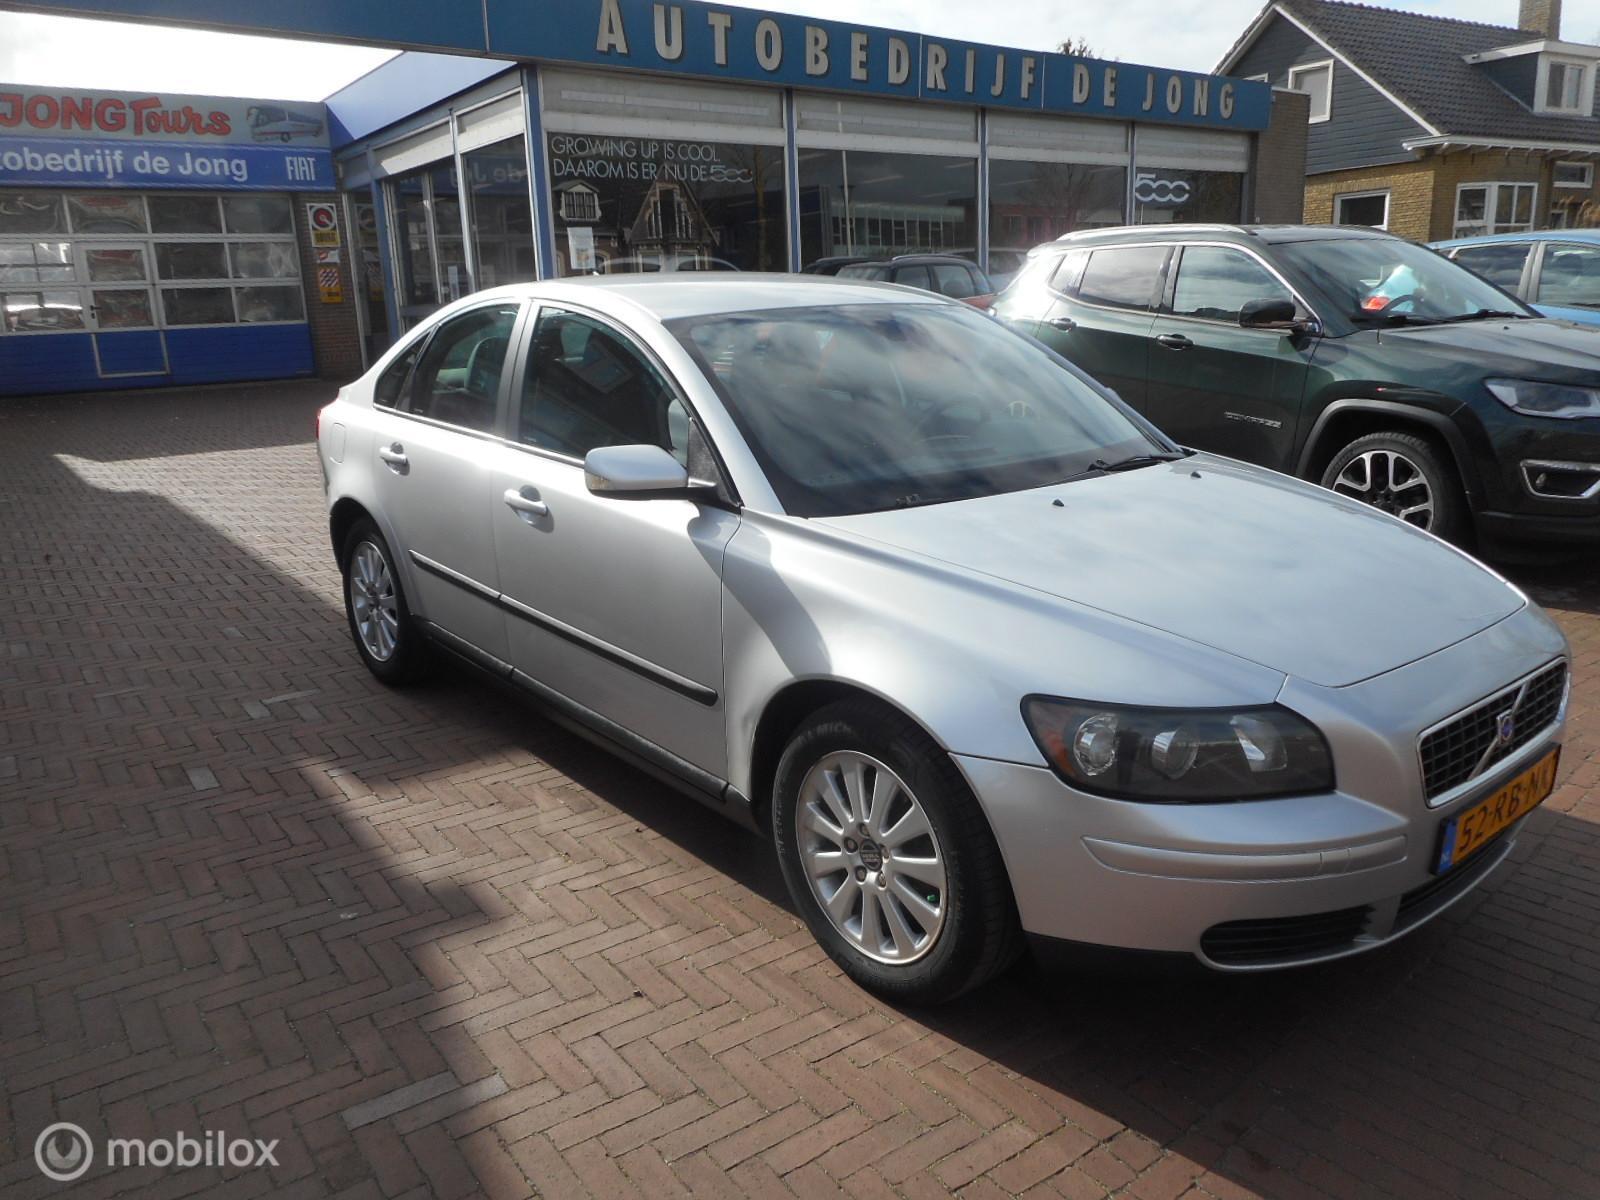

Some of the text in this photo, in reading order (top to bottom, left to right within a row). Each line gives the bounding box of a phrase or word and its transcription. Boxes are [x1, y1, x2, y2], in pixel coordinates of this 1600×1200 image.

[596, 0, 1234, 119] AUTOBEDRIJF DE JONG
[0, 92, 232, 136] JONG Tours
[551, 135, 637, 158] GROWING
[640, 141, 659, 159] UP
[664, 143, 675, 160] IS
[0, 145, 249, 181] obedrijf de Jong
[285, 156, 317, 181] FIAT
[553, 158, 625, 180] DAAROM
[627, 161, 638, 180] IS
[643, 163, 658, 180] ER
[664, 164, 688, 181] NU
[691, 165, 708, 182] DE
[1134, 173, 1191, 202] 500
